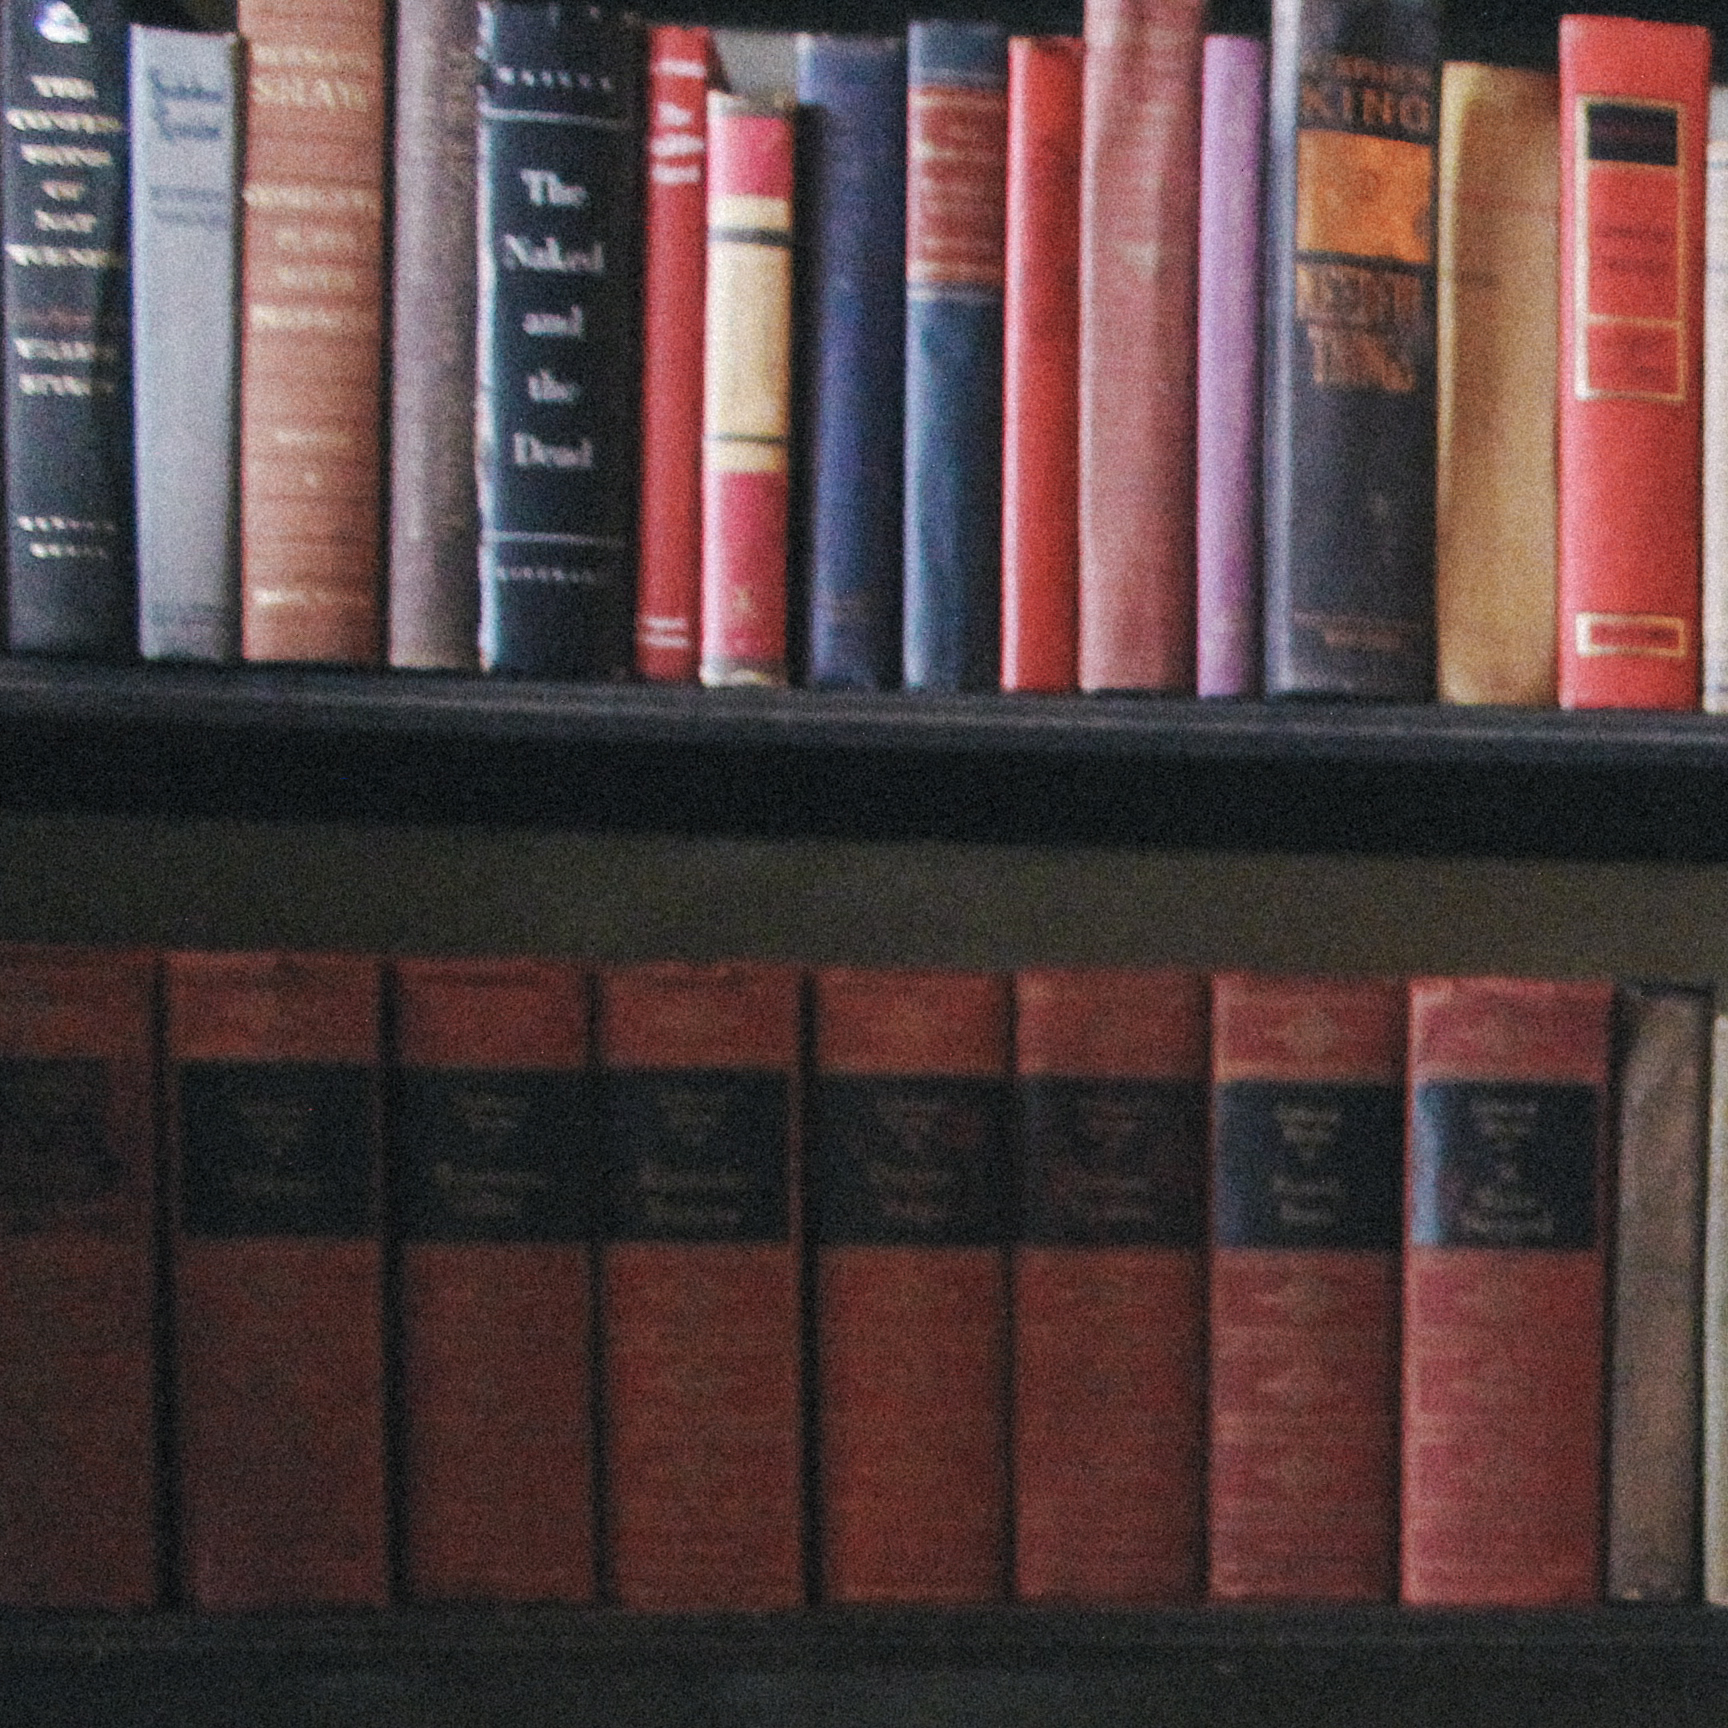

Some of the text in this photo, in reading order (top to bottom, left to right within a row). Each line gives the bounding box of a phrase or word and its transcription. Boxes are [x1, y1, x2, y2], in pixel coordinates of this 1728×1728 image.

[1300, 85, 1431, 131] KING
[520, 169, 588, 205] The
[504, 234, 604, 274] Naked
[521, 304, 584, 341] and
[526, 367, 582, 403] the
[513, 431, 594, 468] Dead
